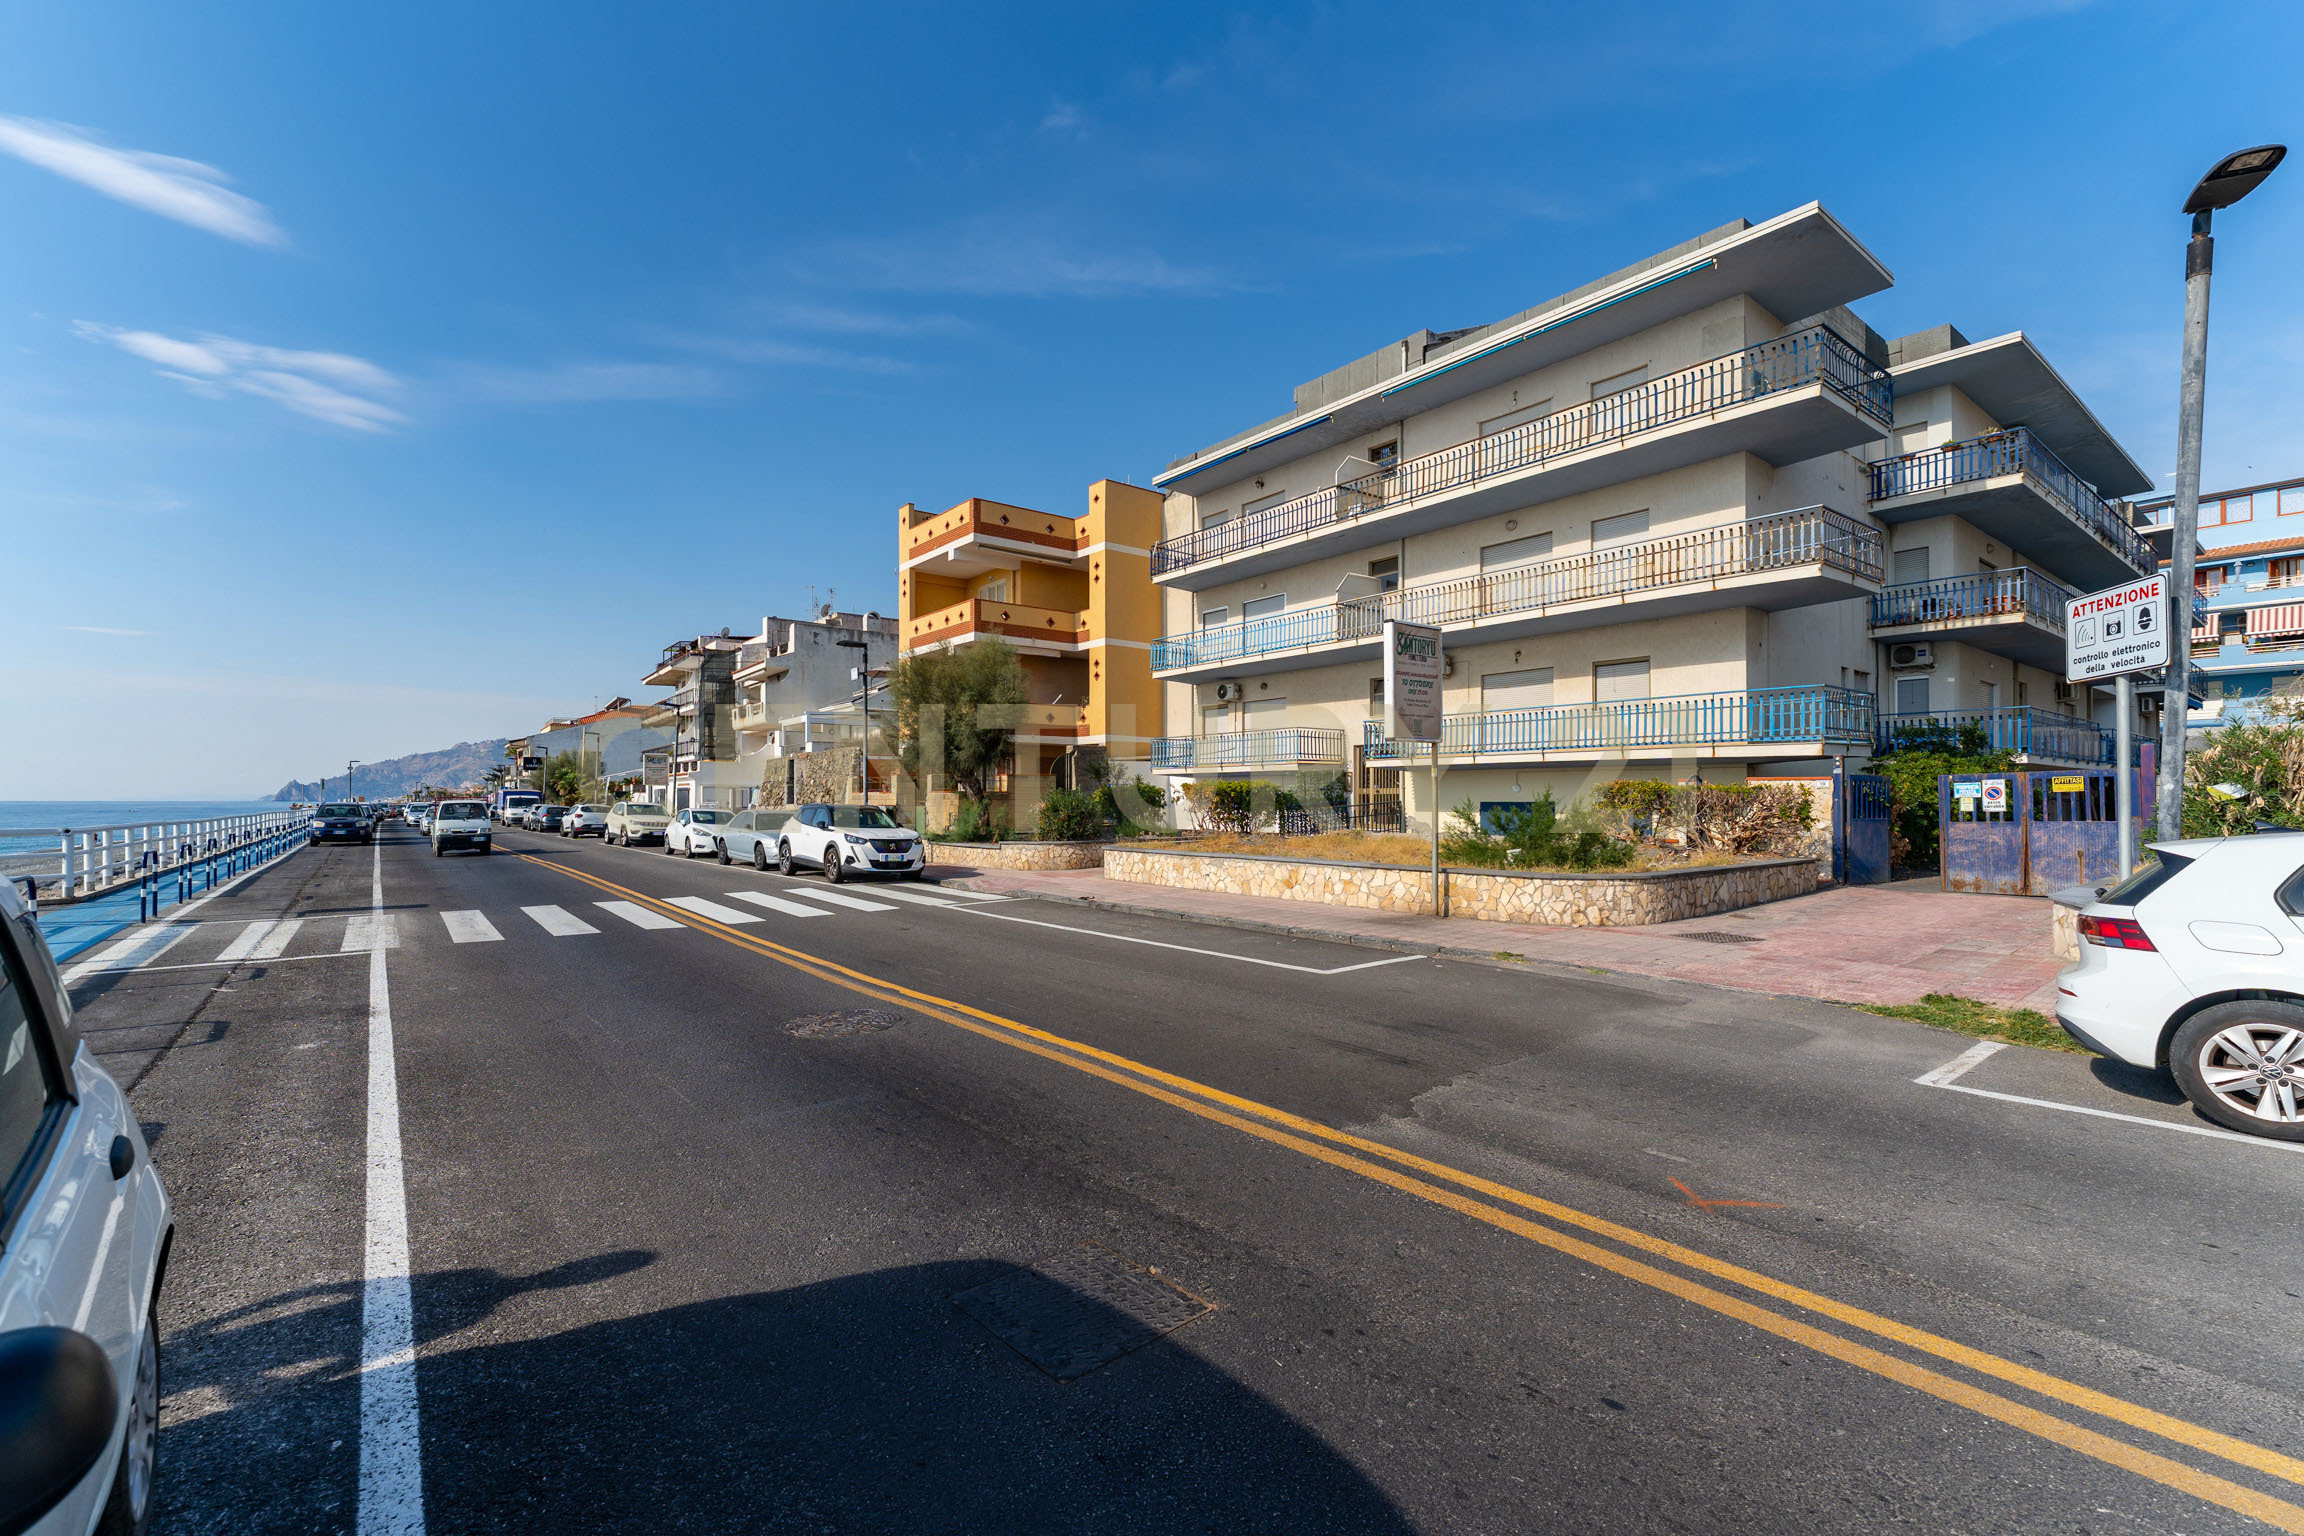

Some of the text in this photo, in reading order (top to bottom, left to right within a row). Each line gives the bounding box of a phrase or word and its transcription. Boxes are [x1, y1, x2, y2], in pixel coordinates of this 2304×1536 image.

[2072, 582, 2160, 619] ATTENZIONE
[2073, 640, 2161, 665] controllo elettronico
[2085, 655, 2145, 674] della velocità
[1409, 679, 1434, 688] OTTOBRE
